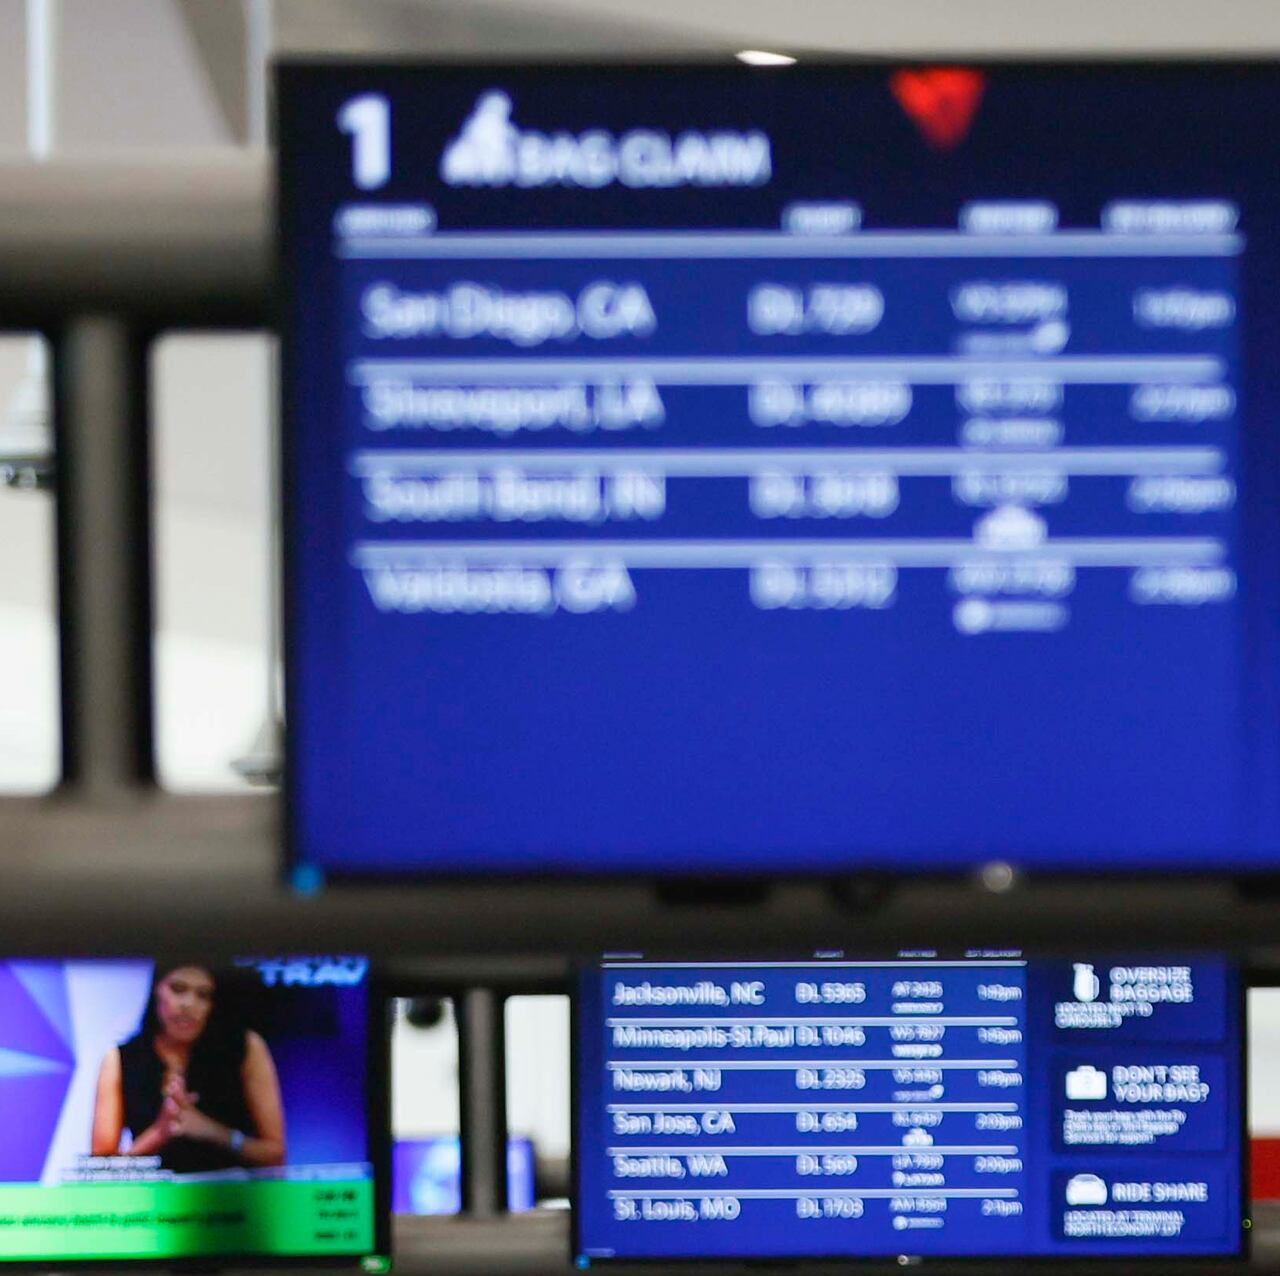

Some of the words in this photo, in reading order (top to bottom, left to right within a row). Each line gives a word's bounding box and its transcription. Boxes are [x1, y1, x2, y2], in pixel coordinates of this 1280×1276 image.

[336, 92, 391, 189] 1
[730, 982, 765, 1005] NC
[795, 983, 821, 1003] DL
[795, 1069, 821, 1089] DL
[613, 1112, 653, 1135] San
[701, 1112, 736, 1134] CA
[795, 1112, 821, 1133] DL
[795, 1155, 821, 1176] DL
[699, 1198, 741, 1221] MO
[795, 1198, 821, 1219] DL
